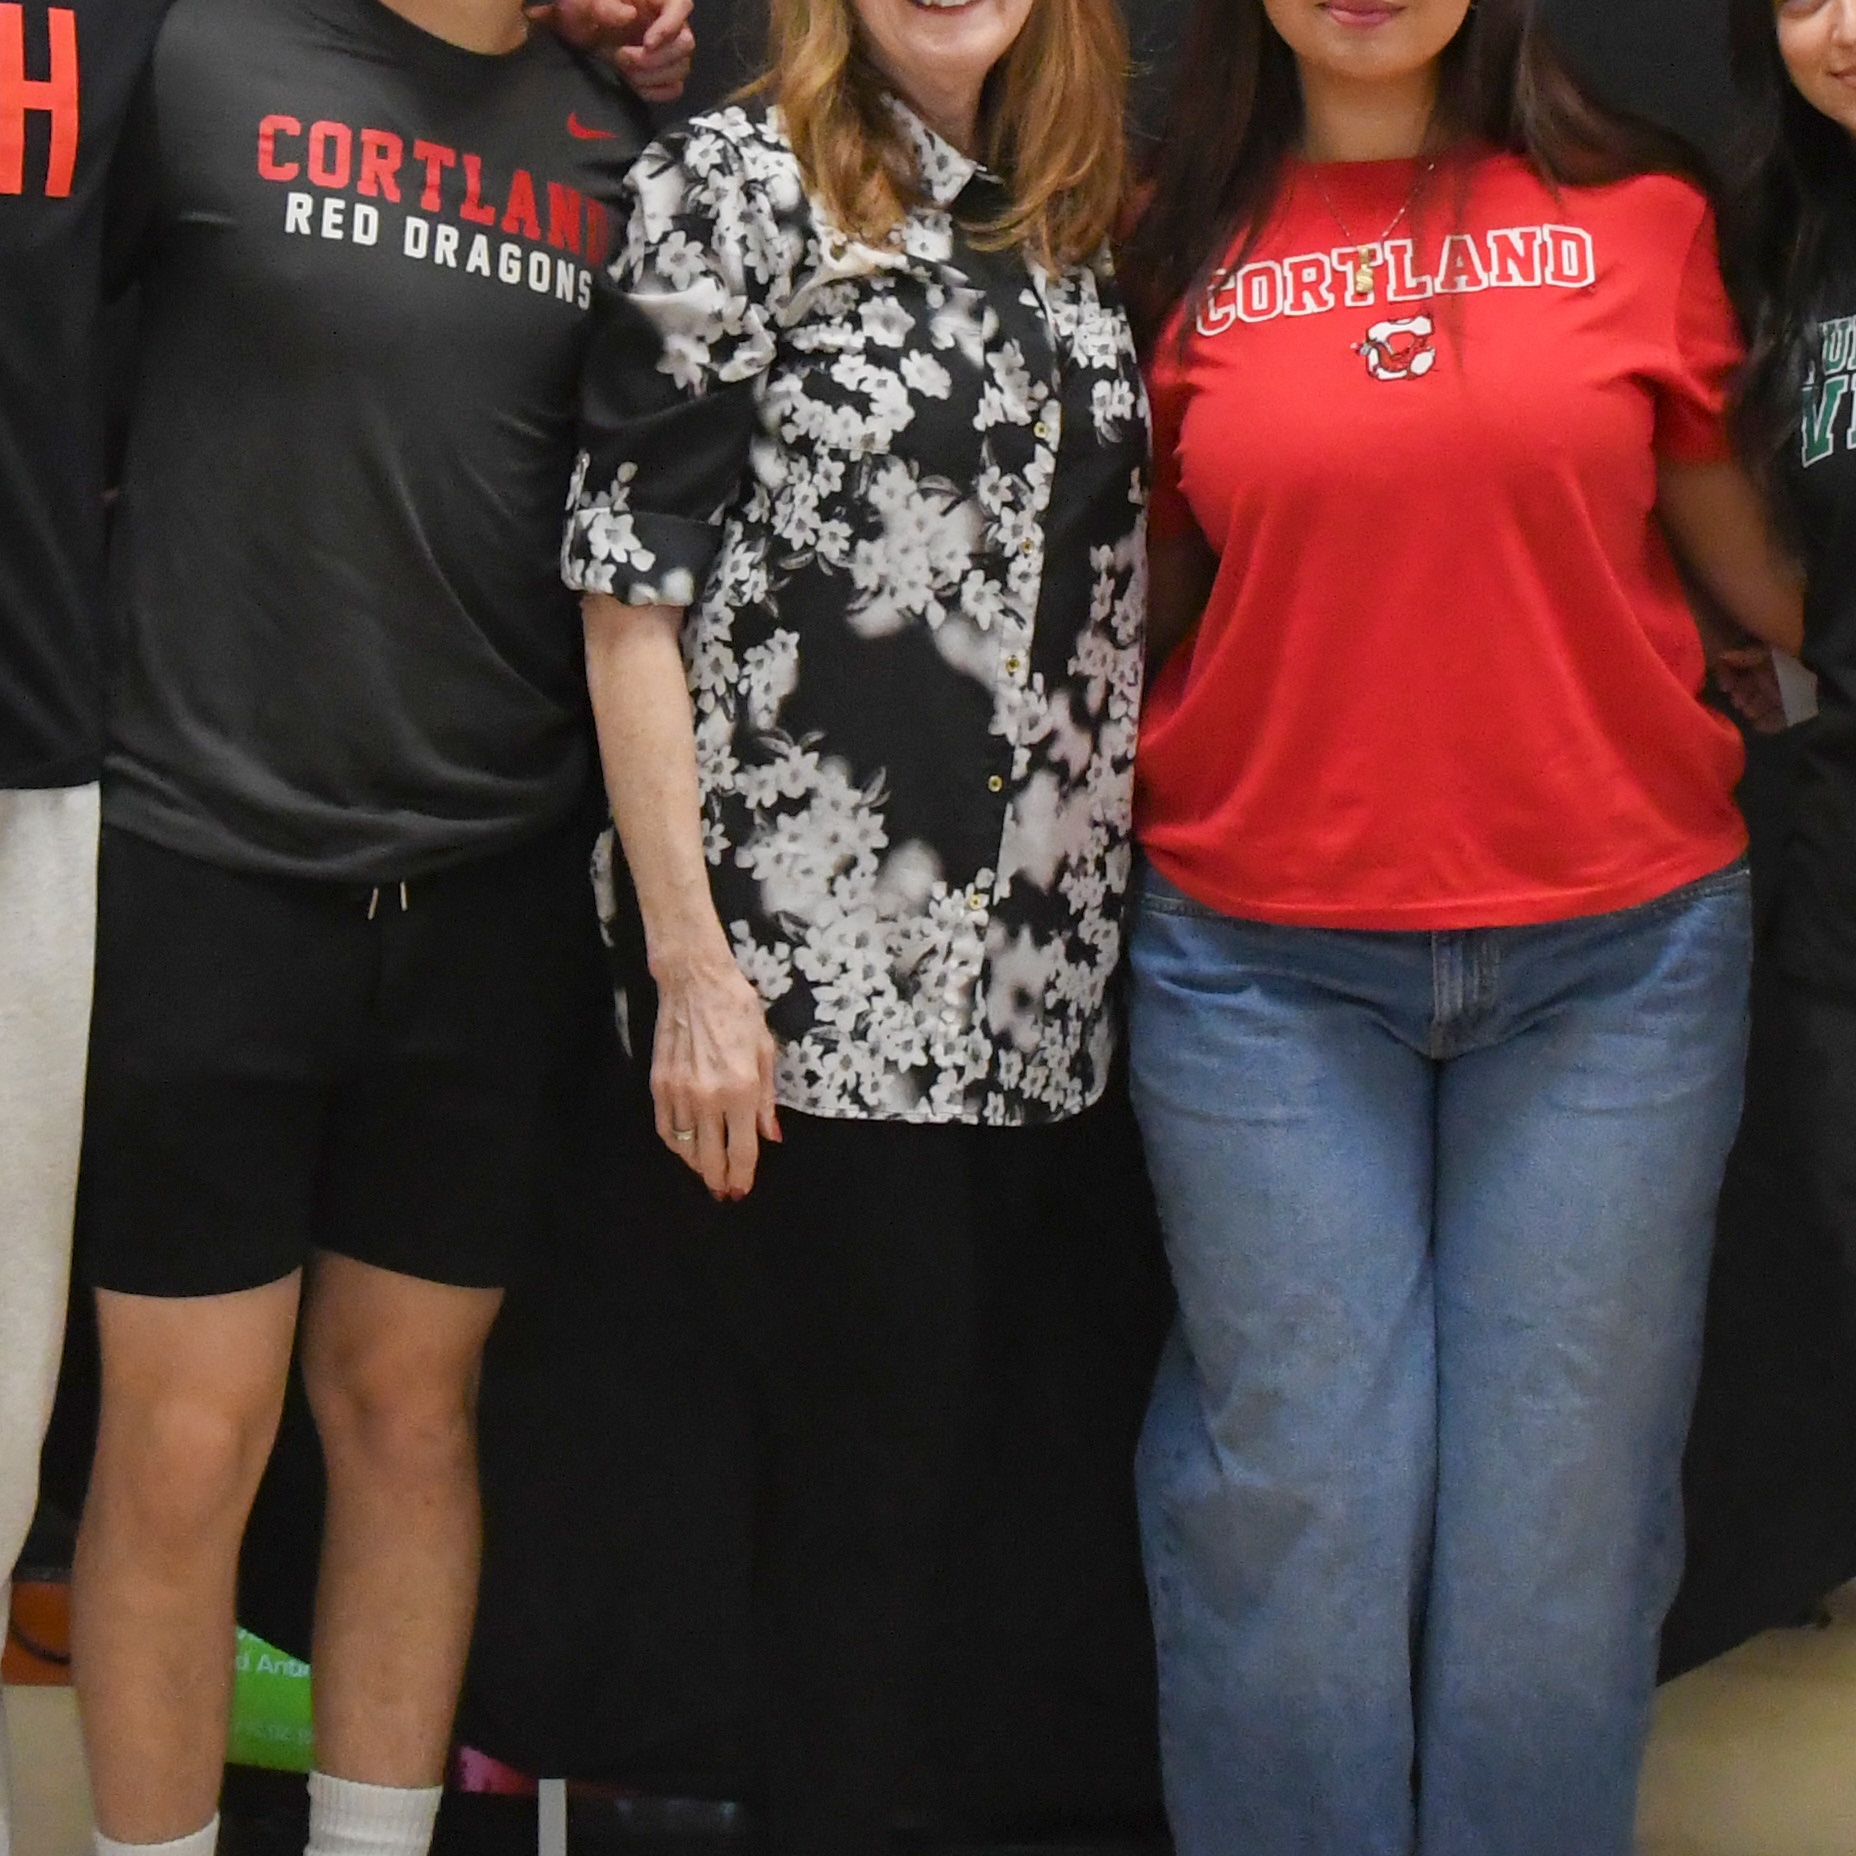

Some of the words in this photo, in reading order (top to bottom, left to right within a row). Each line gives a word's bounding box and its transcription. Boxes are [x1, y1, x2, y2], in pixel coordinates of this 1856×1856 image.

[257, 114, 609, 268] CORTLAND
[285, 192, 379, 246] RED
[404, 216, 593, 311] DRAGONS
[1197, 224, 1596, 336] CORTLAND
